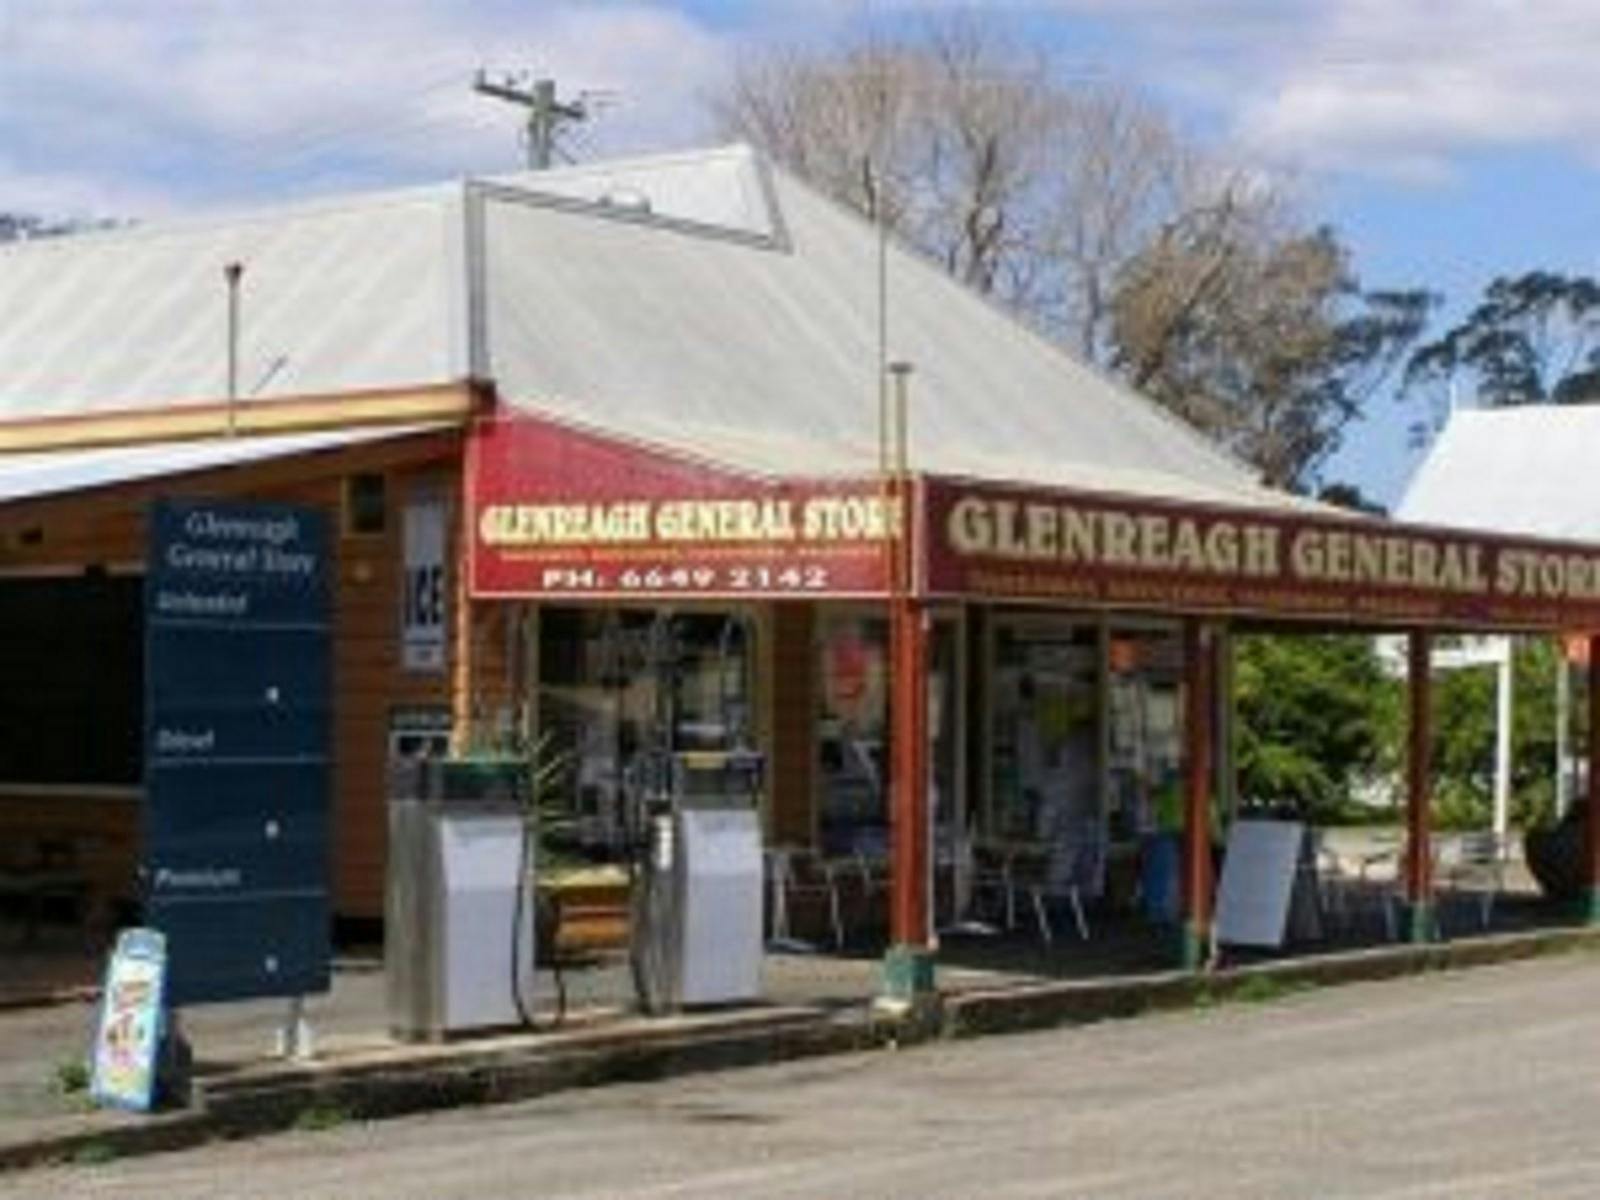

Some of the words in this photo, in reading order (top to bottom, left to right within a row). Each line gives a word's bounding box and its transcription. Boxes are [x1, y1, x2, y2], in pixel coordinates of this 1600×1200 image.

[480, 504, 650, 544] GLENREAGH
[656, 498, 796, 540] GENERAL
[949, 498, 1281, 575] GLENREAGH
[1290, 527, 1487, 592] GENERAL
[728, 566, 829, 588] 2142
